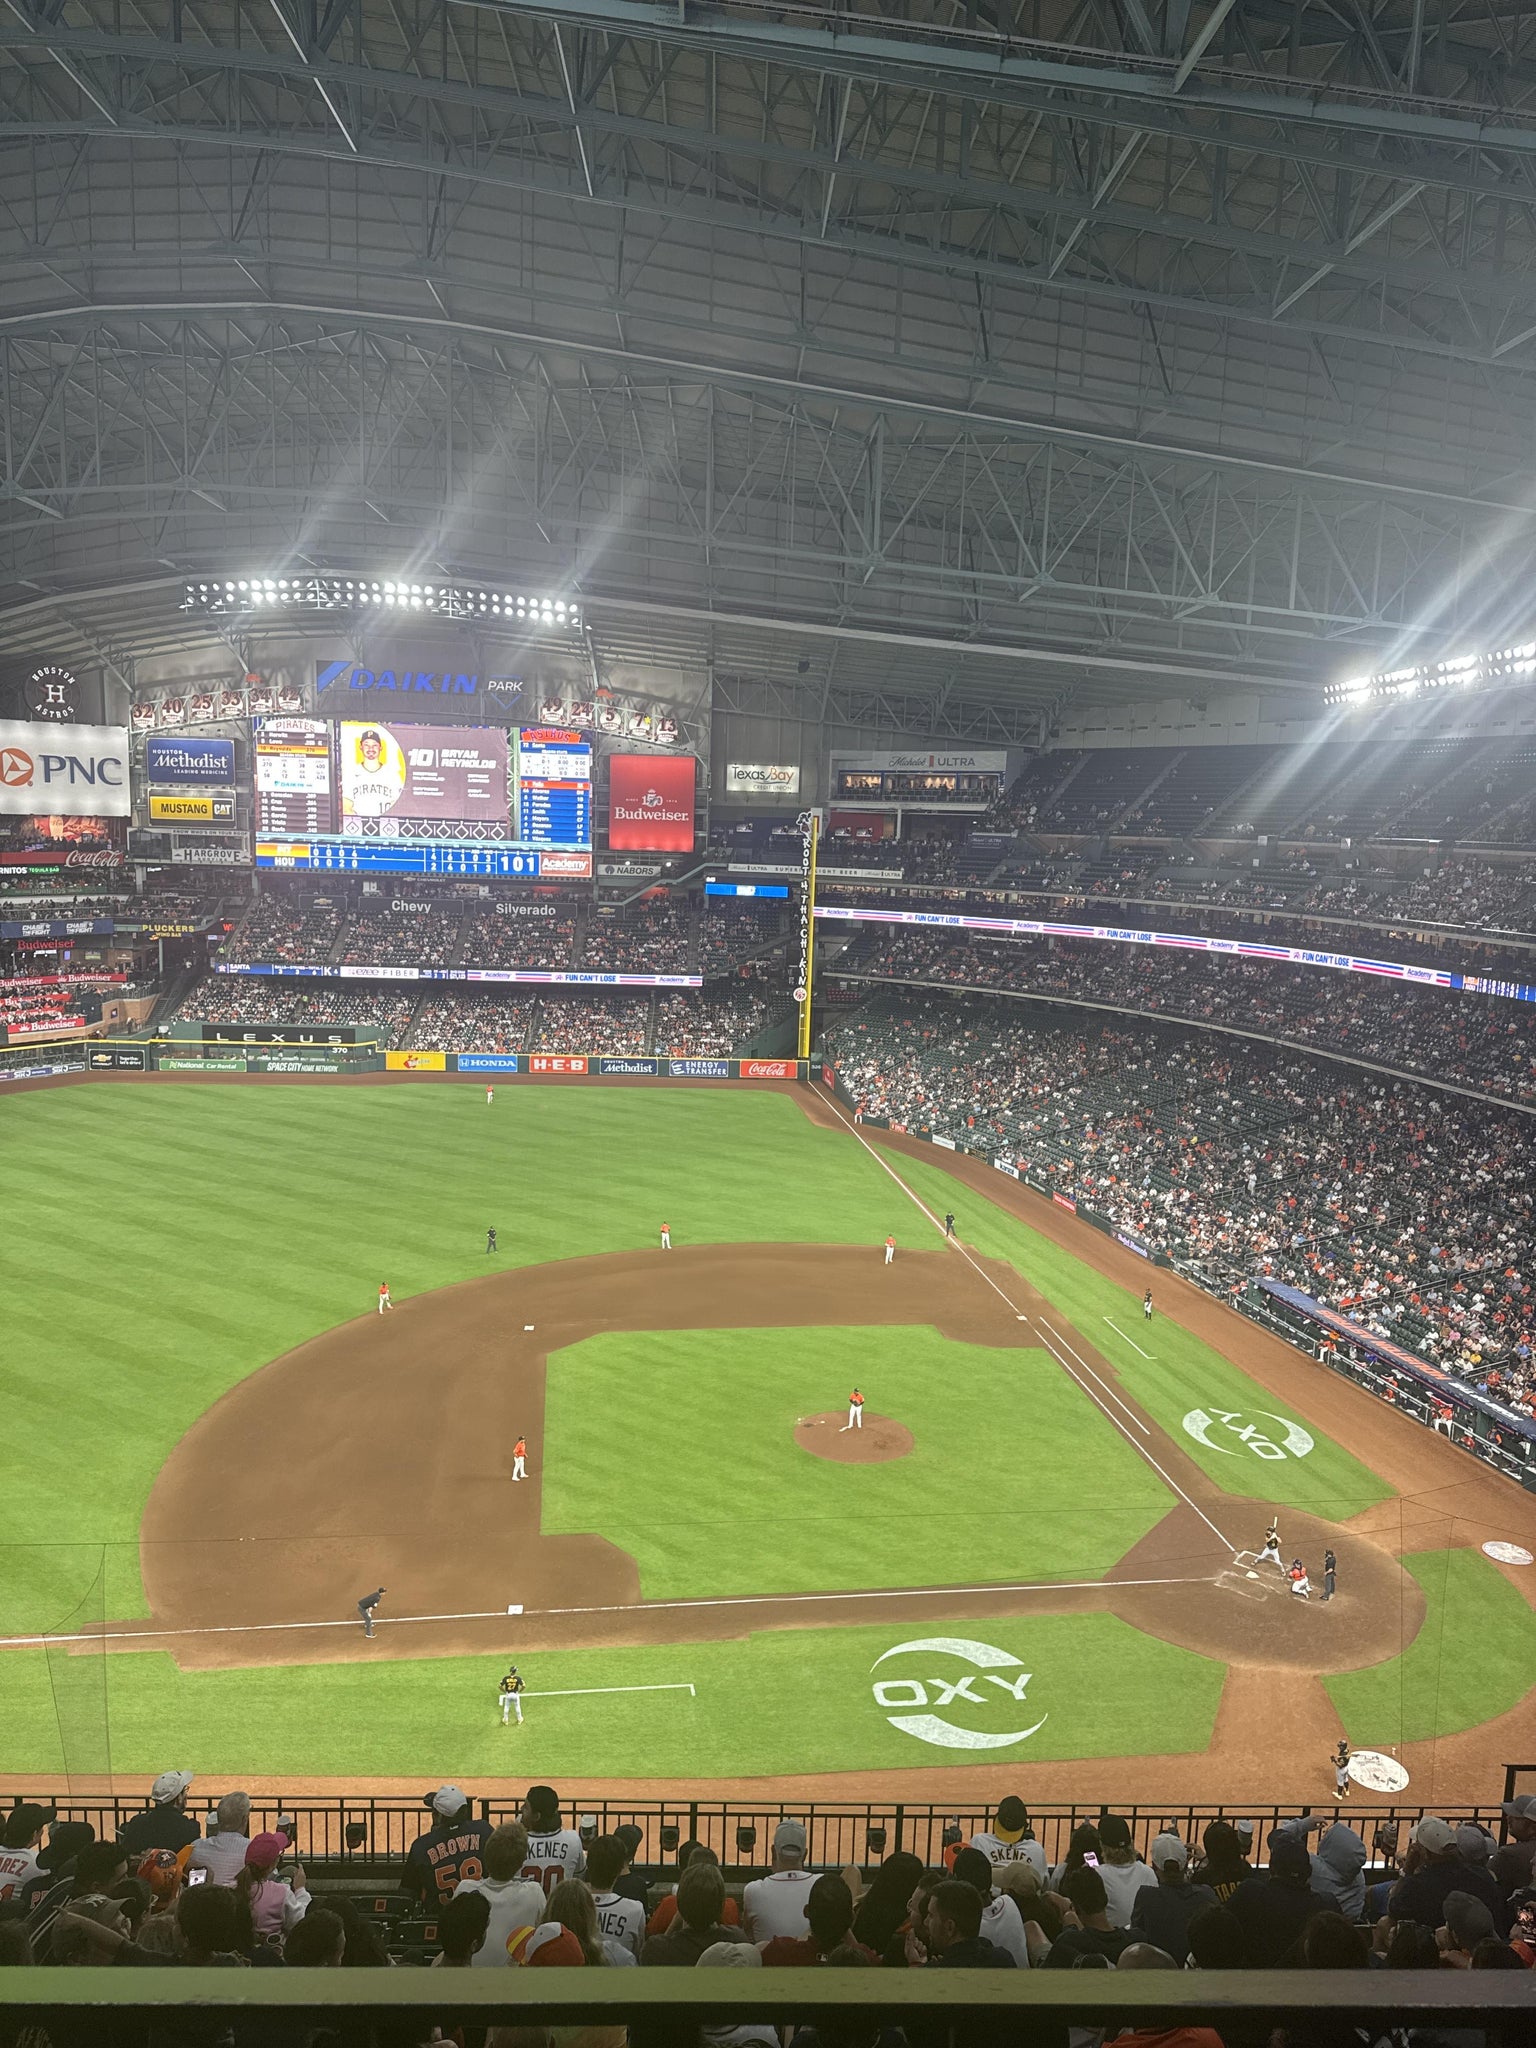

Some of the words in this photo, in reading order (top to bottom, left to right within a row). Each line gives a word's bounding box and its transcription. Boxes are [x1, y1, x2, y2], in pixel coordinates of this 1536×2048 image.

[32, 667, 75, 684] HOUSTON
[350, 669, 478, 694] DAIKIN
[488, 681, 522, 692] PARK
[221, 691, 241, 706] 33
[251, 688, 272, 702] 34
[279, 687, 300, 700] 42
[162, 698, 182, 713] 40
[192, 694, 210, 710] 25
[542, 697, 562, 712] 49
[572, 702, 592, 716] 24
[35, 704, 74, 718] ASTROS
[134, 704, 151, 718] 32
[606, 708, 614, 721] 5
[276, 720, 314, 732] PIRATES
[635, 713, 644, 727] 7
[659, 718, 676, 732] 13
[153, 752, 228, 768] Methodist
[408, 749, 434, 766] 10
[441, 749, 478, 759] BRYAN
[441, 758, 496, 769] REYNOLDS
[889, 756, 926, 767] Michelob
[938, 758, 975, 766] ULTRA
[38, 754, 123, 785] PNC
[732, 767, 765, 780] Texas
[769, 767, 794, 784] Bay
[161, 804, 208, 814] MUSTANG
[214, 804, 231, 815] CAT
[184, 849, 241, 862] HARGROVE
[274, 857, 295, 866] HOU
[802, 838, 811, 876] ROOT
[542, 858, 588, 871] Academy
[801, 882, 808, 891] 4
[392, 900, 431, 914] Chevy
[496, 904, 556, 916] Silverado
[800, 895, 808, 925] THA
[18, 940, 75, 950] Budweiser
[798, 928, 808, 986] CHIKIN
[1107, 930, 1118, 938] FUN
[1119, 931, 1136, 939] CAN'T
[1138, 933, 1152, 941] LOSE
[1211, 940, 1234, 949] Academy
[1302, 952, 1315, 962] FUN
[1316, 953, 1333, 965] CAN'T
[1335, 956, 1349, 966] LOSE
[1407, 968, 1432, 979] Academy
[324, 967, 332, 976] K
[485, 971, 511, 979] Academy
[32, 1020, 76, 1030] Budweiser
[217, 1032, 341, 1043] LEXUS
[267, 1062, 287, 1072] SPACE
[287, 1063, 302, 1072] CITY
[604, 1061, 652, 1073] Methodist
[872, 1674, 1033, 1706] OXY
[427, 1834, 480, 1865] BROWN
[528, 1841, 568, 1860] KENES
